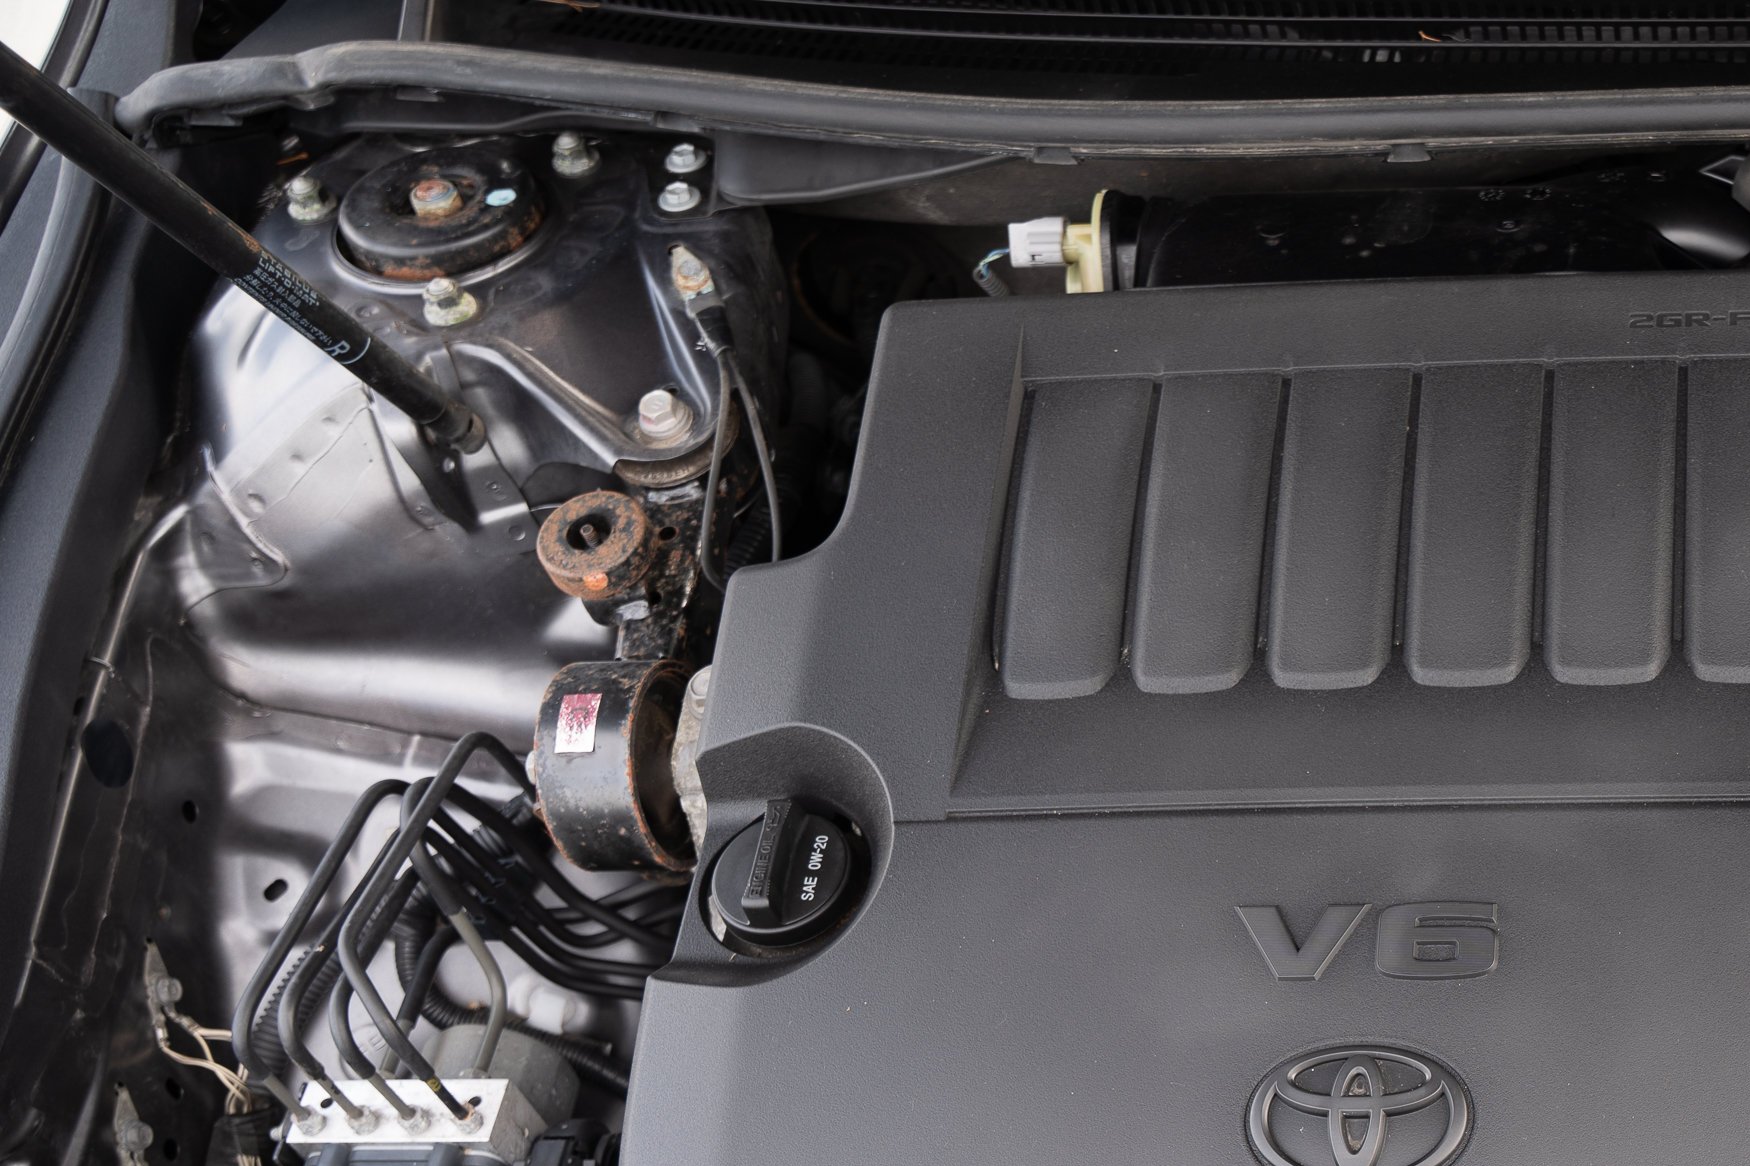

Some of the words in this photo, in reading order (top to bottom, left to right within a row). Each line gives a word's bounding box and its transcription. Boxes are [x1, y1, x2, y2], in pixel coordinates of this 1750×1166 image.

[808, 835, 829, 870] 0W-20
[801, 877, 818, 901] SAE
[1234, 900, 1500, 981] V6
